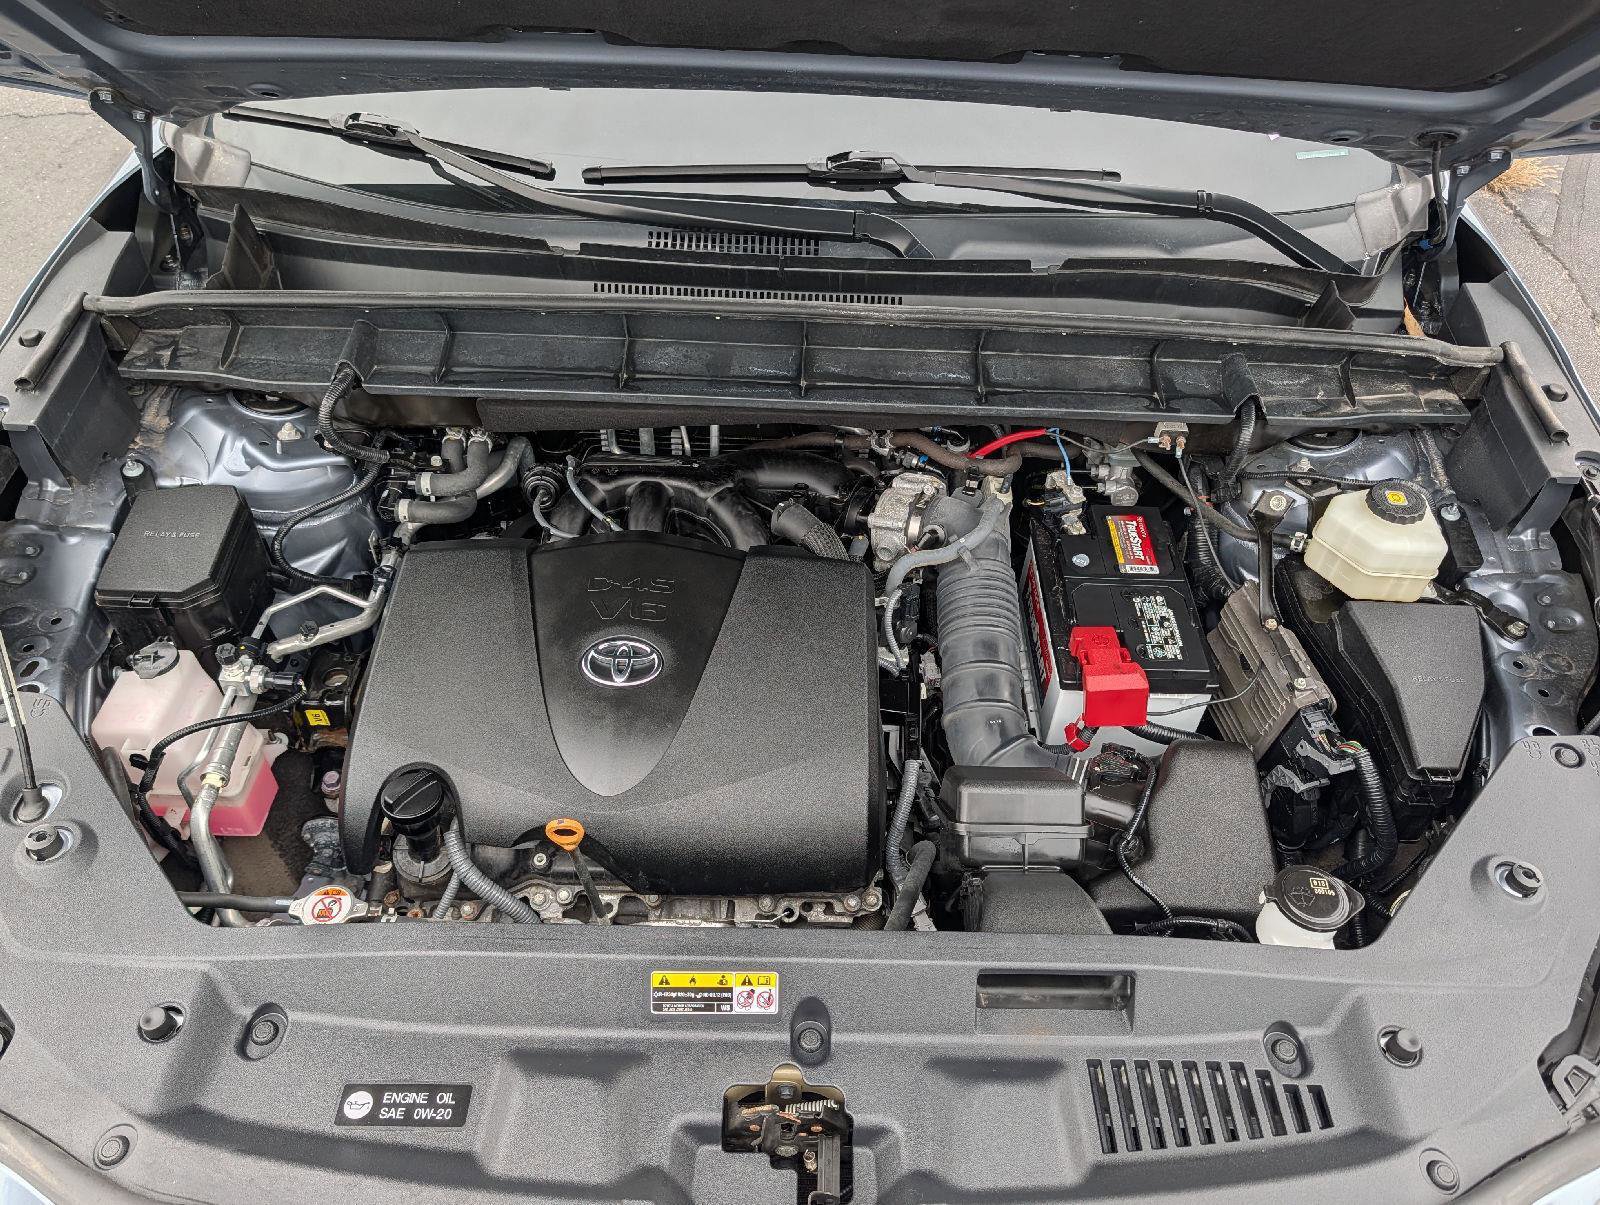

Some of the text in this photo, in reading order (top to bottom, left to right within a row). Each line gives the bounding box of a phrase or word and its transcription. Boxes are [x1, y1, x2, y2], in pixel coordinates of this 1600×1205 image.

[590, 599, 668, 622] V6
[382, 1092, 456, 1104] ENGINE OIL
[379, 1108, 452, 1120] SAE 0W-20
